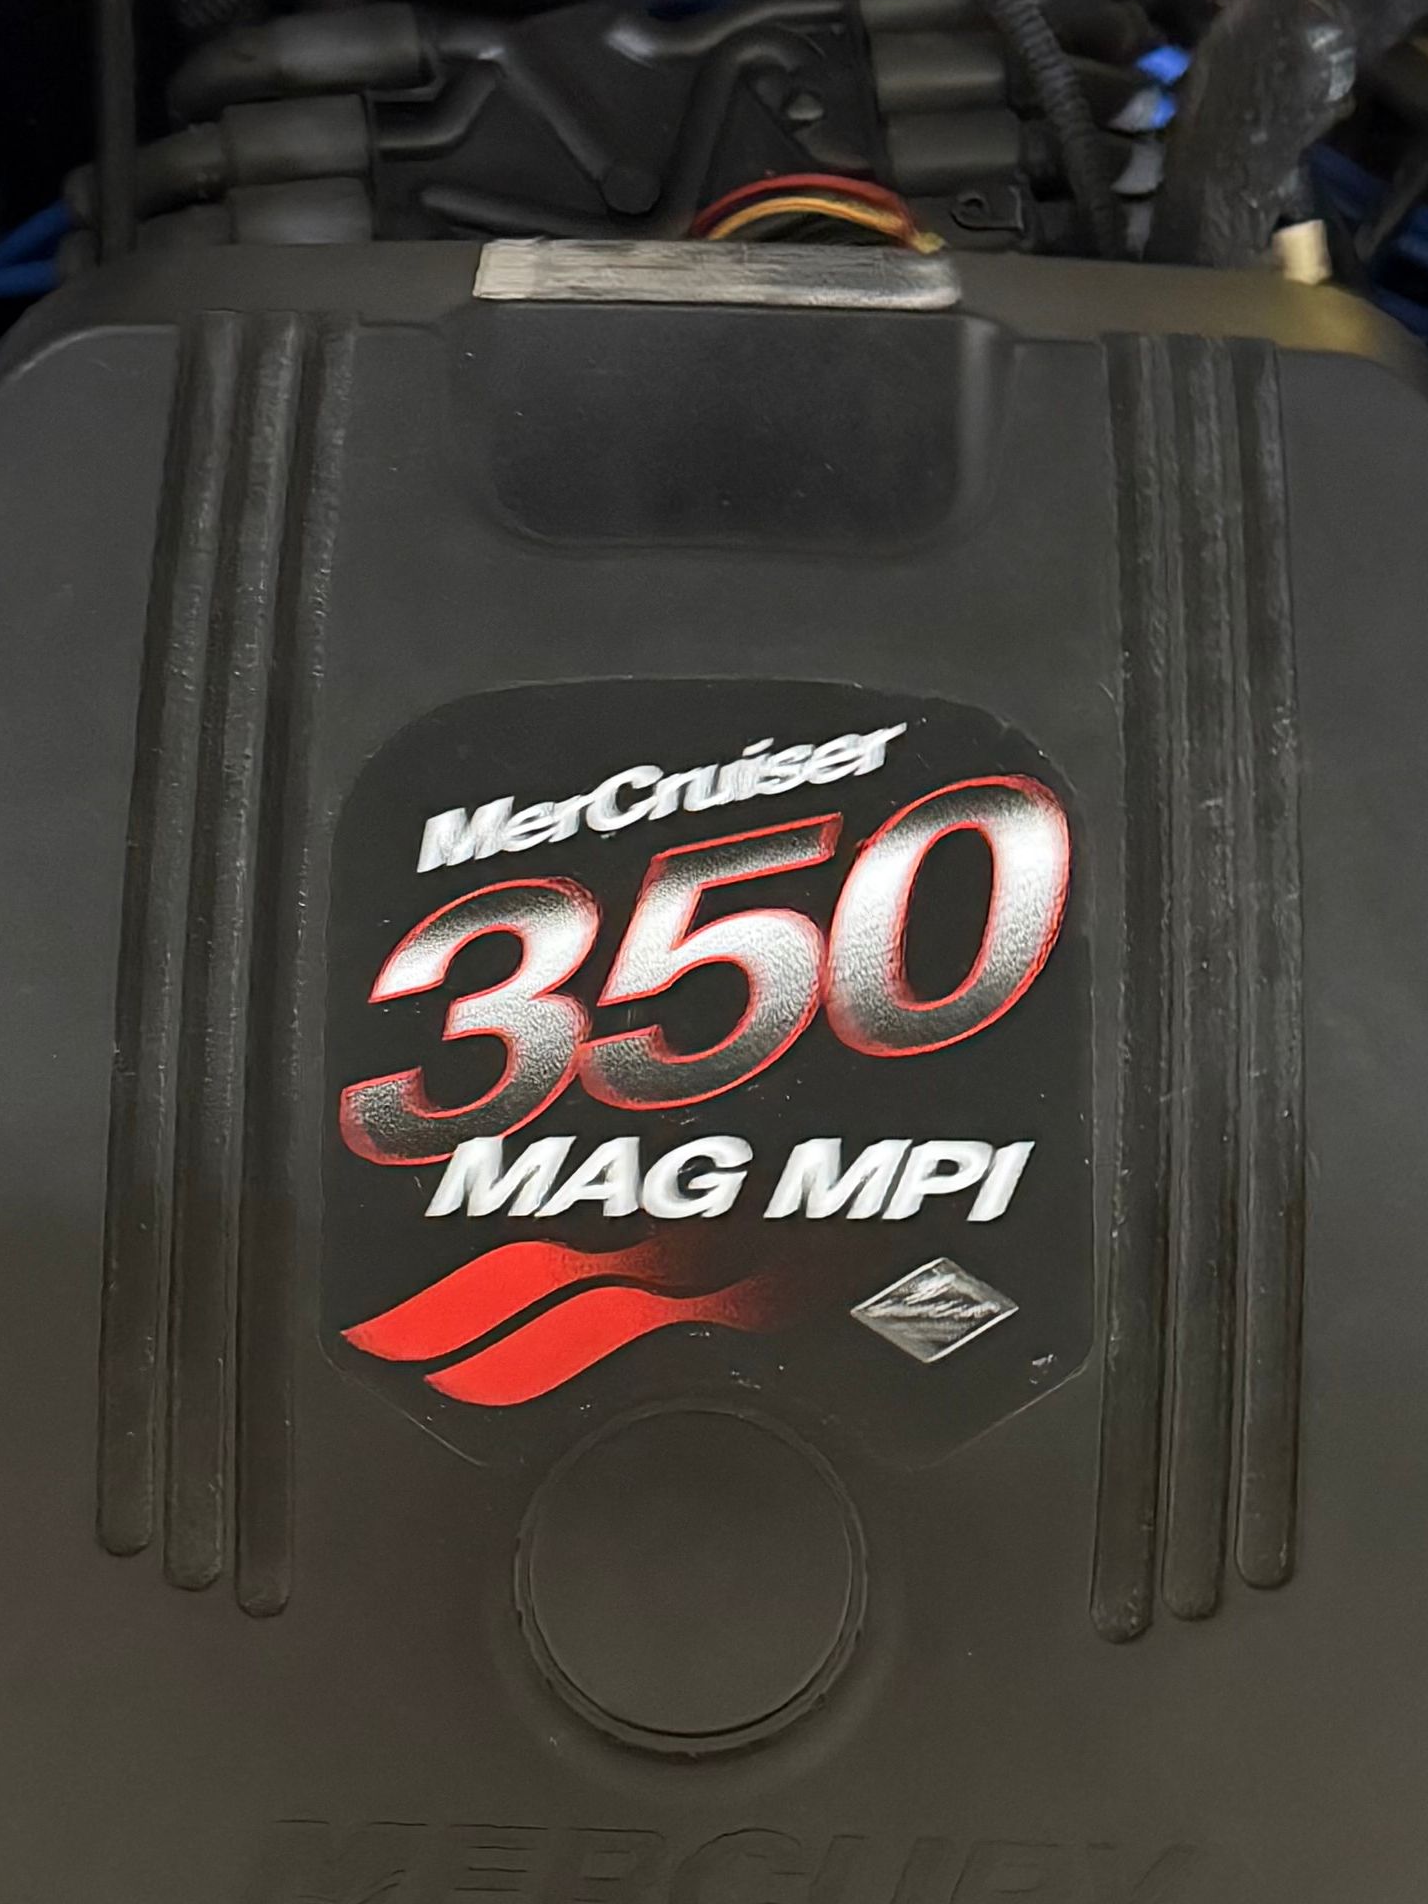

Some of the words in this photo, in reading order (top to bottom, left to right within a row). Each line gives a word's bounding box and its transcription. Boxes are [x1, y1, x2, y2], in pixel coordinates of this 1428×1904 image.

[416, 722, 908, 873] MerCruiser
[339, 773, 1074, 1166] 350
[424, 1135, 755, 1221] MAG
[763, 1137, 1036, 1223] MPI
